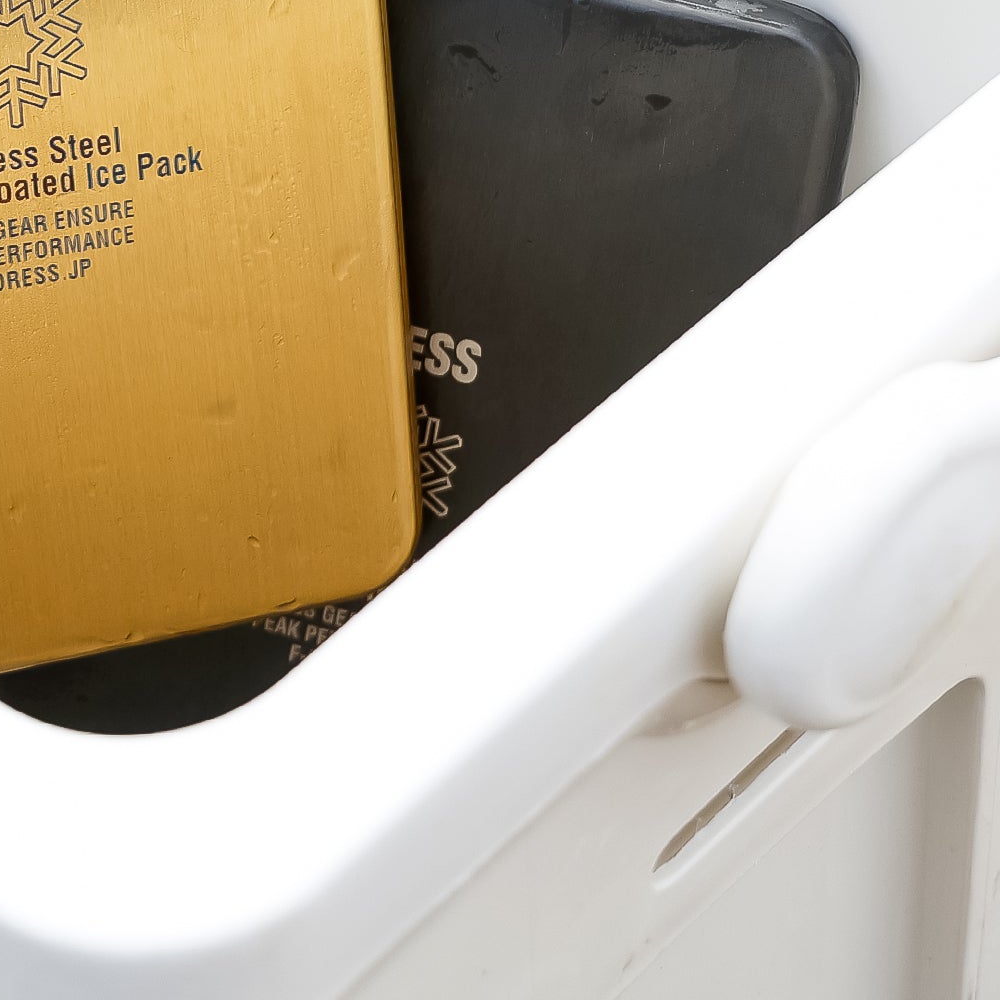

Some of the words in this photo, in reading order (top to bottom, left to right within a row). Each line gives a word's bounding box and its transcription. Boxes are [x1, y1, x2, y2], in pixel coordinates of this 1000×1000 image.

[50, 126, 122, 164] Steel
[87, 162, 127, 189] Ice
[138, 146, 203, 180] Pack
[55, 200, 135, 229] ENSURE
[252, 616, 300, 639] EAK
